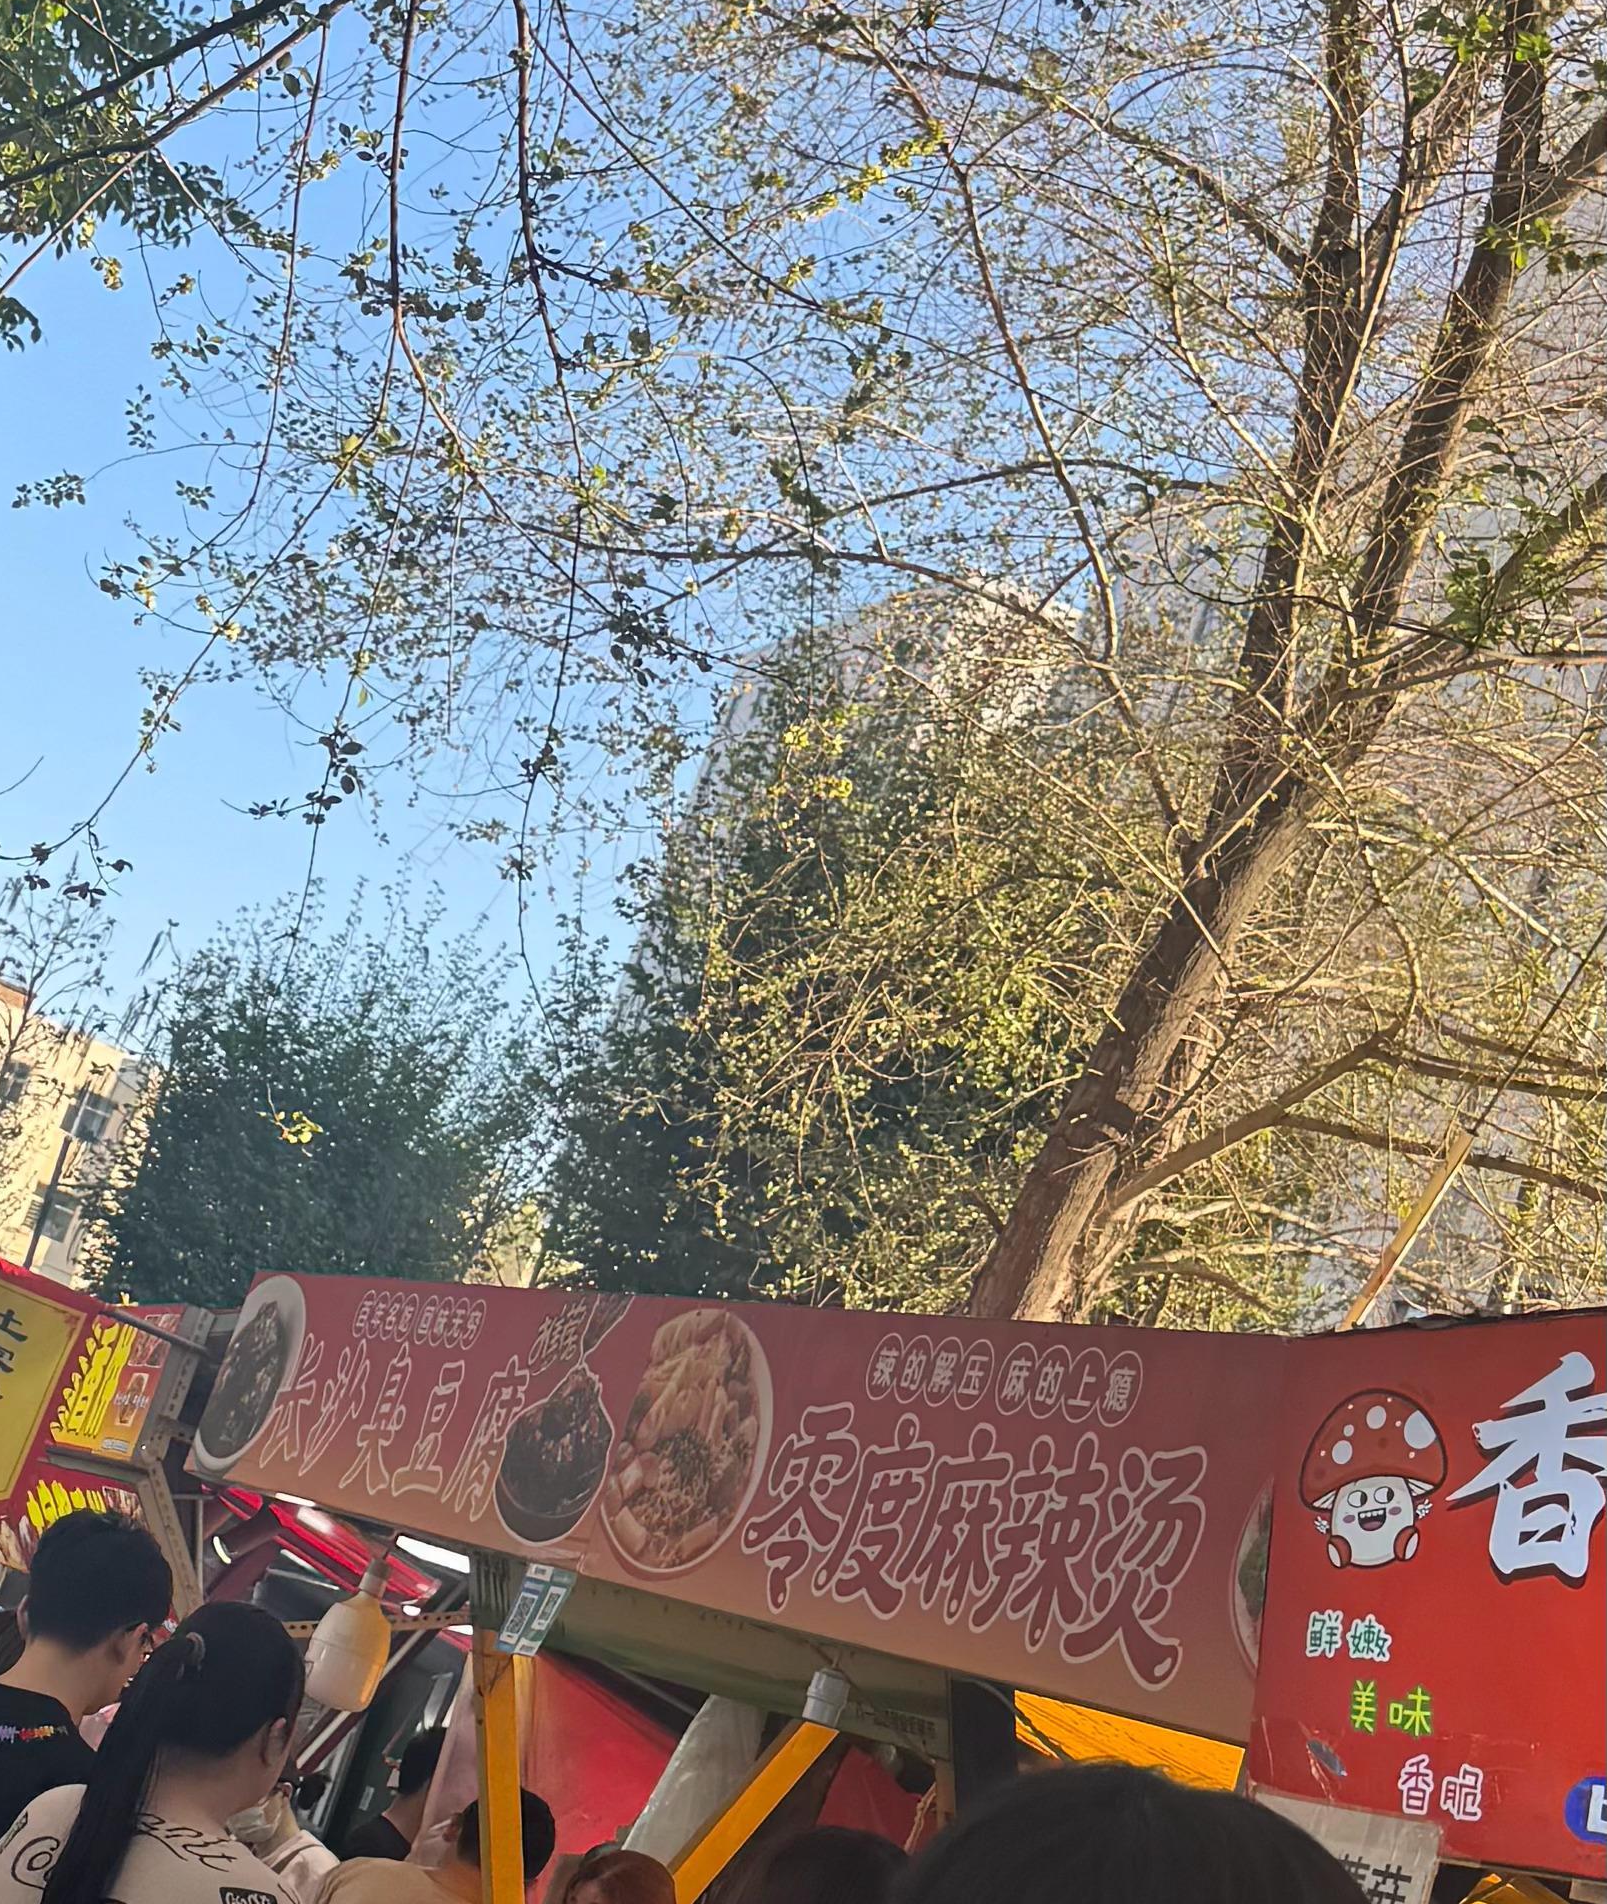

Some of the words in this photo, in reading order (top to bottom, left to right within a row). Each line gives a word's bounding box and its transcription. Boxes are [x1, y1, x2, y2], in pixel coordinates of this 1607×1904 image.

[871, 1346, 991, 1397] 辣的解压
[1000, 1356, 1137, 1414] 麻的上瘾
[258, 1332, 530, 1523] 长沙臭豆腐
[741, 1400, 1207, 1691] 零度麻辣烫
[1305, 1609, 1392, 1663] 鲜嫩
[1349, 1679, 1434, 1738] 美味
[1397, 1753, 1484, 1822] 香脆
